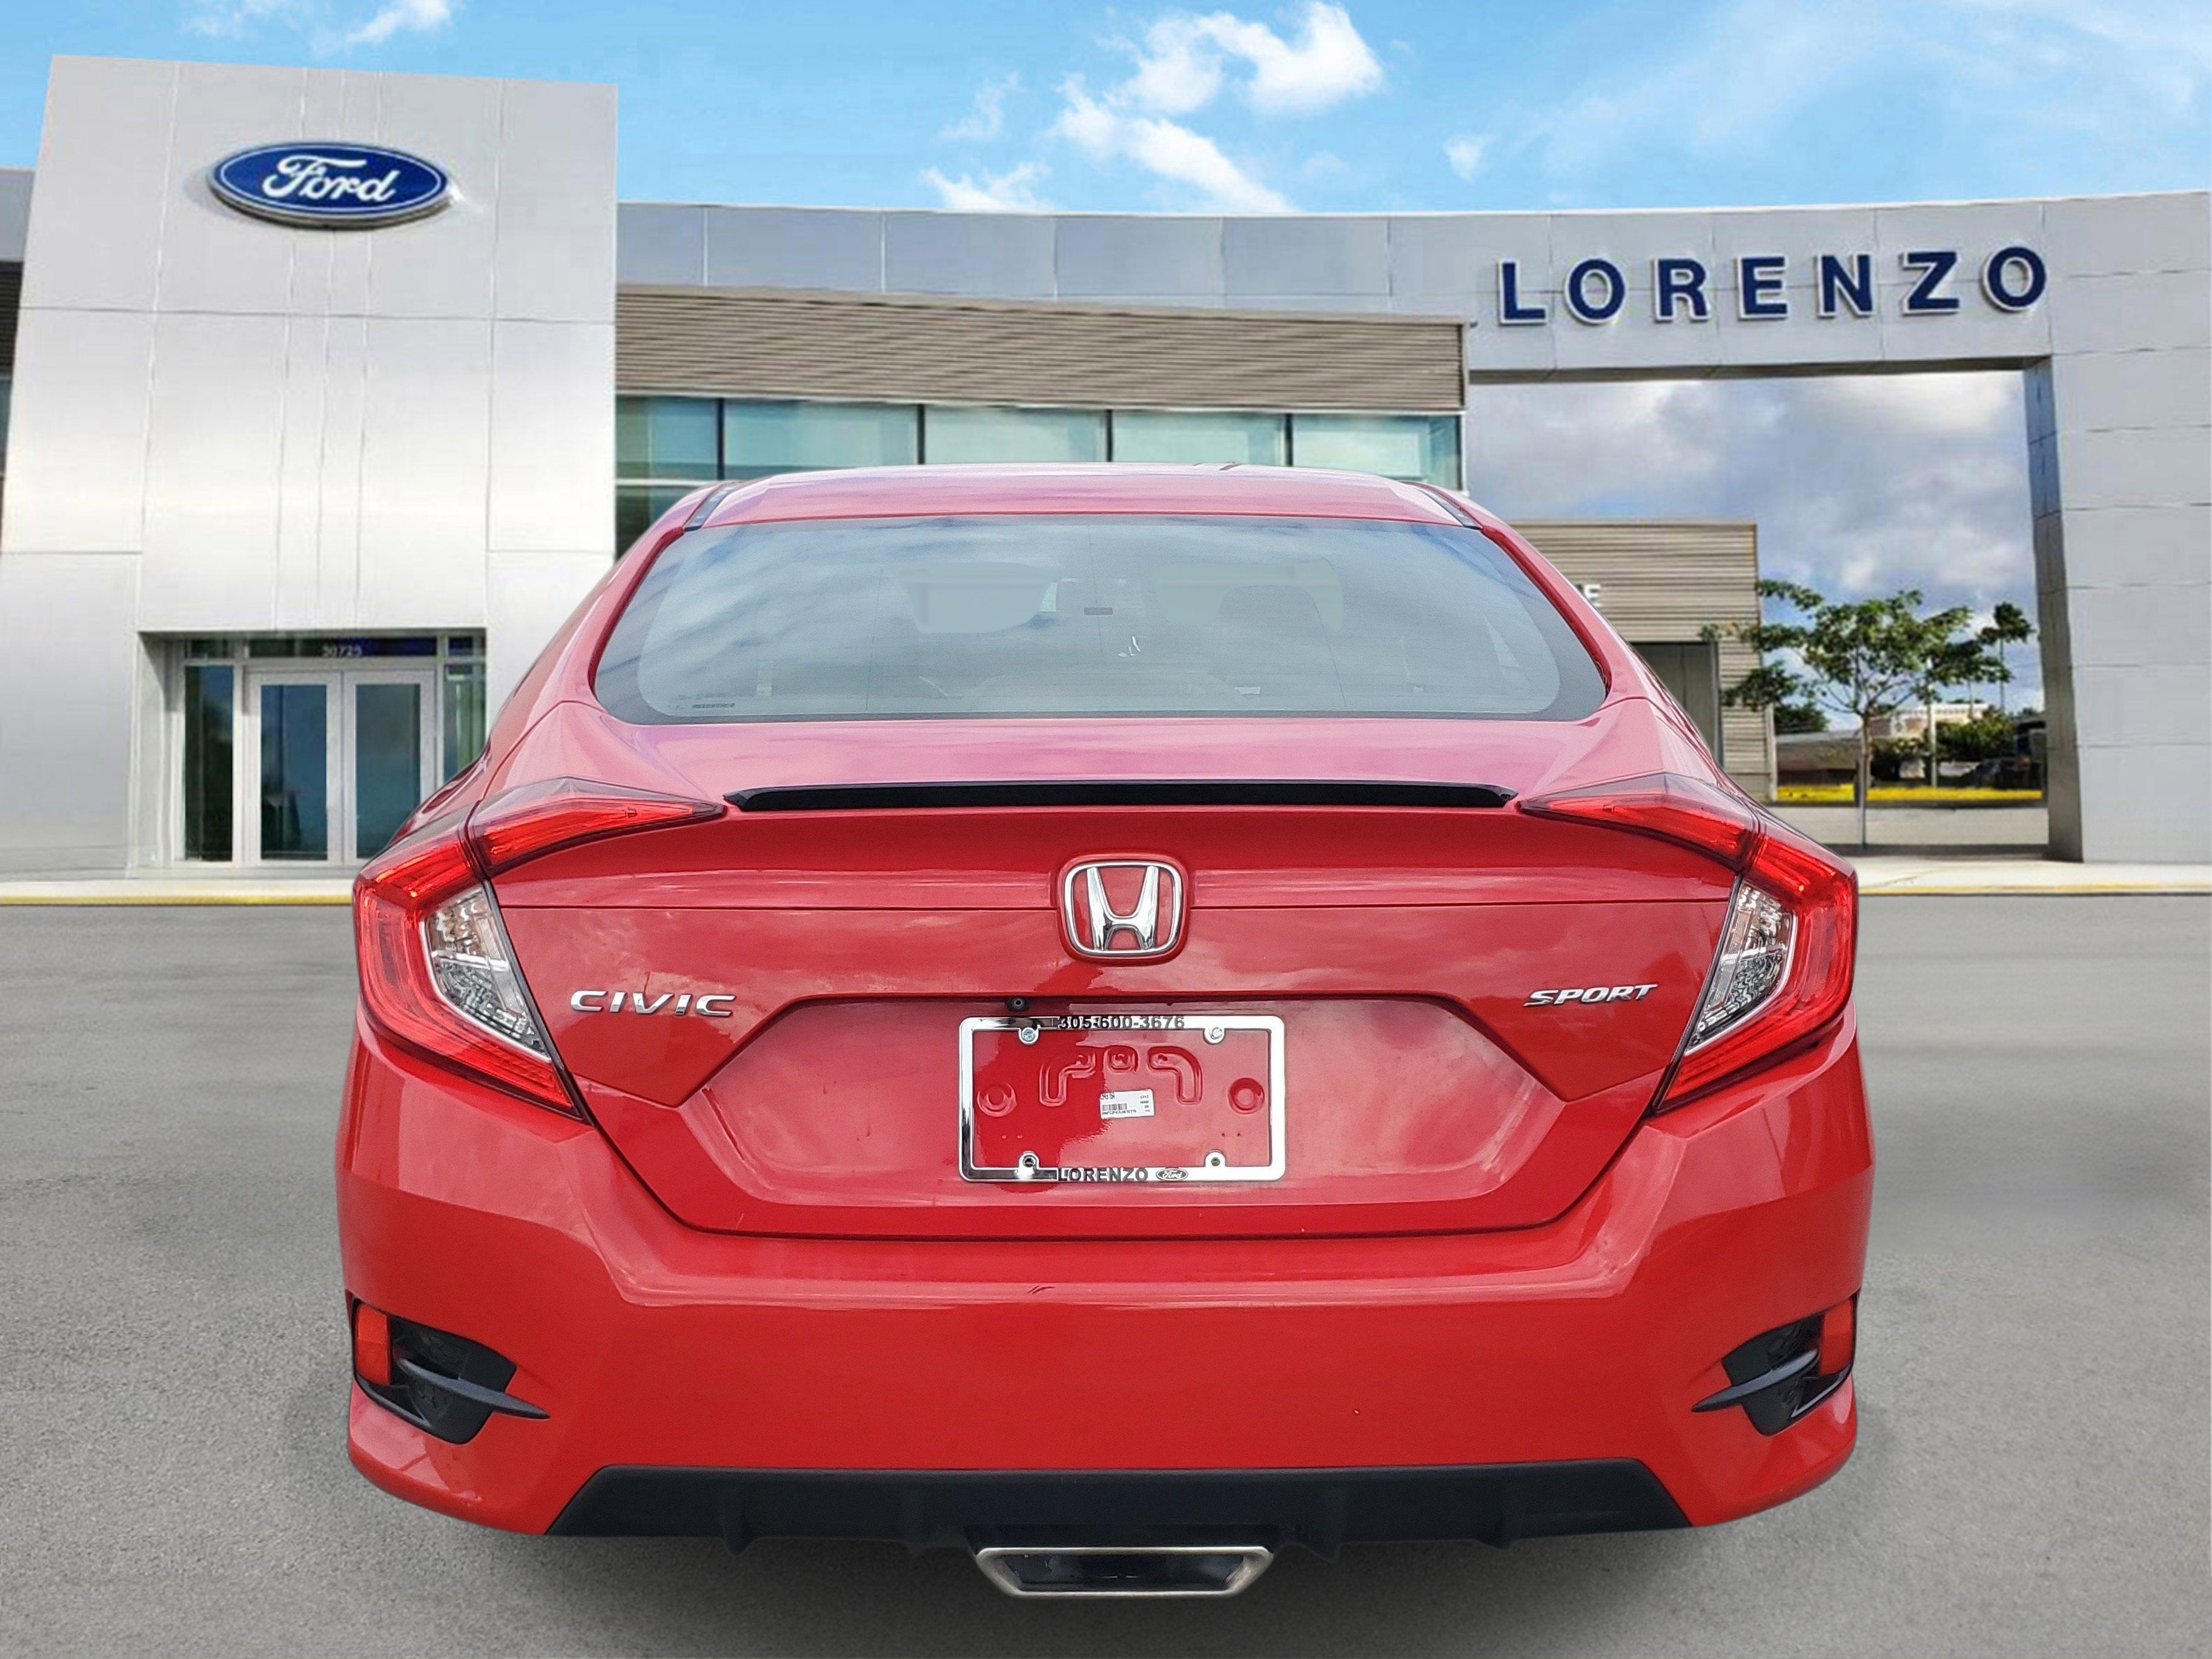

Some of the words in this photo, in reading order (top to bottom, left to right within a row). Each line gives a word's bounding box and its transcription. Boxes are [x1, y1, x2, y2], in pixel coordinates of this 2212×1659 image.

[262, 155, 400, 202] Ford
[1498, 246, 2047, 324] LORENZO
[570, 990, 736, 1017] CIVIC
[1523, 984, 1658, 1007] SPORT
[1059, 1015, 1185, 1029] 305-600-3676
[1059, 1167, 1148, 1182] LORENZO
